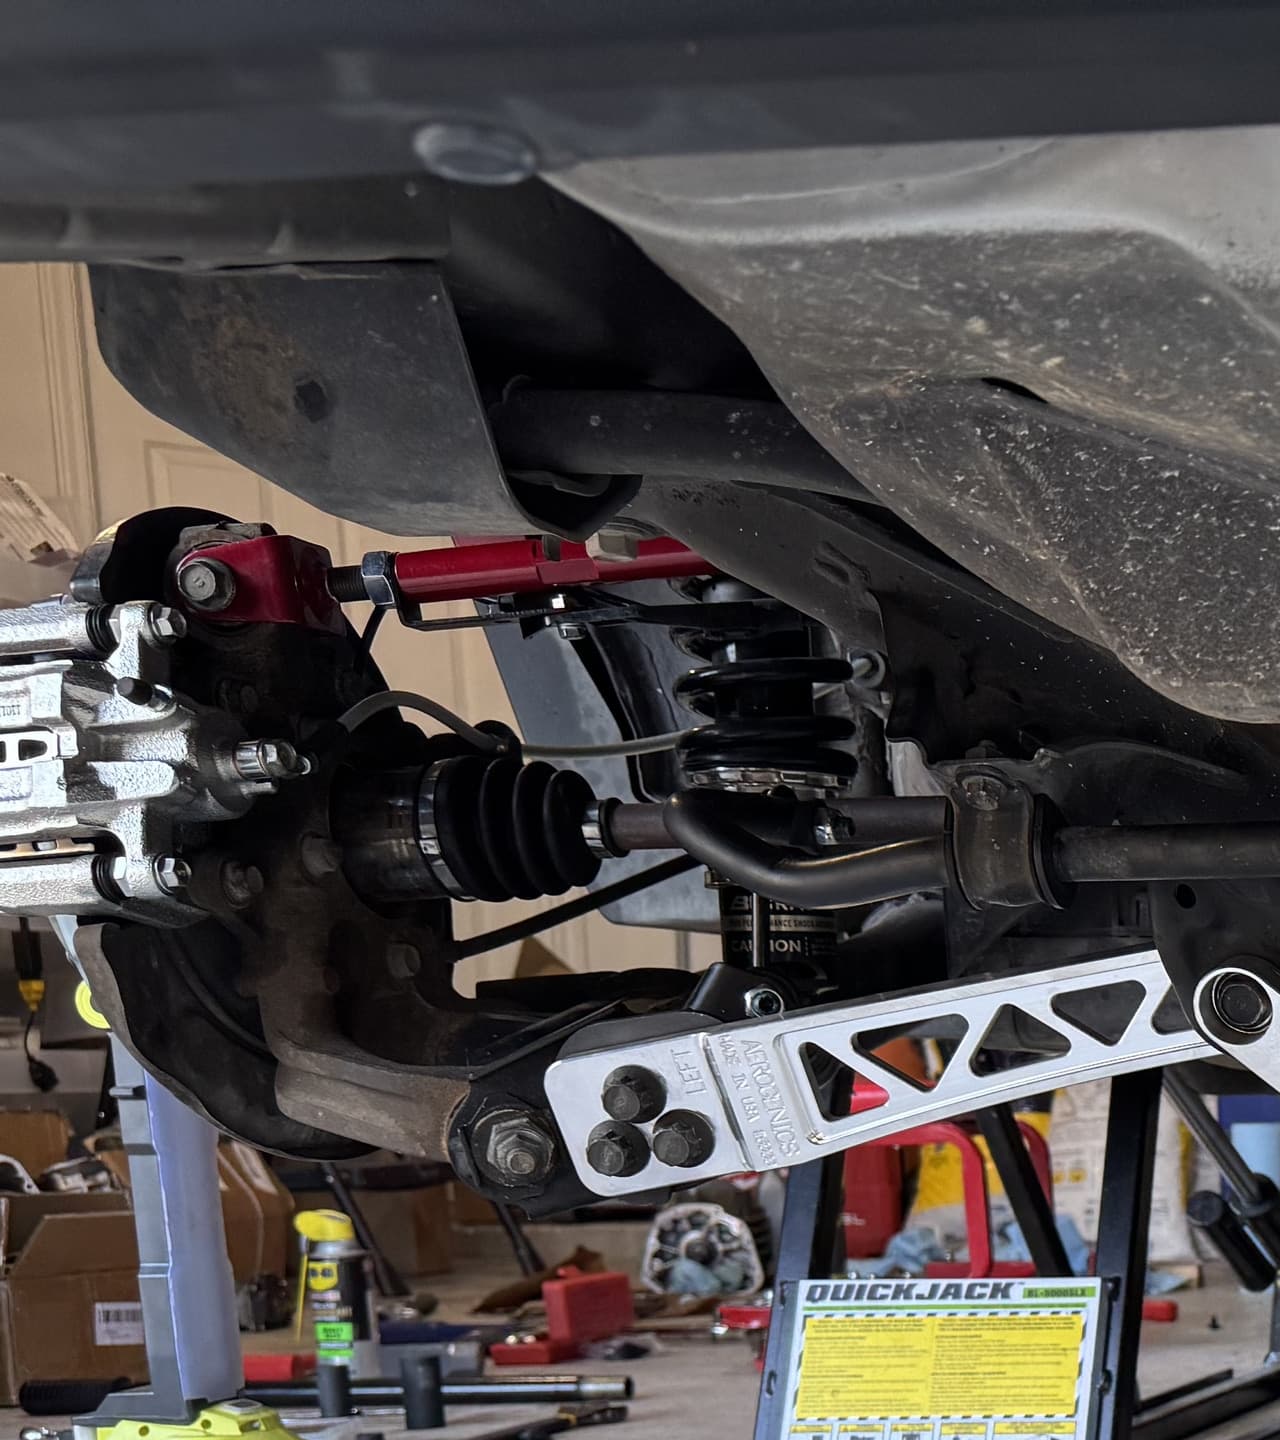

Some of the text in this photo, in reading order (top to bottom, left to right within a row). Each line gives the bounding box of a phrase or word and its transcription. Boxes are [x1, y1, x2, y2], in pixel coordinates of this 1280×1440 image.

[731, 938, 802, 953] CAION
[671, 1048, 708, 1095] LEFT
[741, 1040, 801, 1157] AEROGENICS
[806, 1282, 1015, 1302] QUICKJACK
